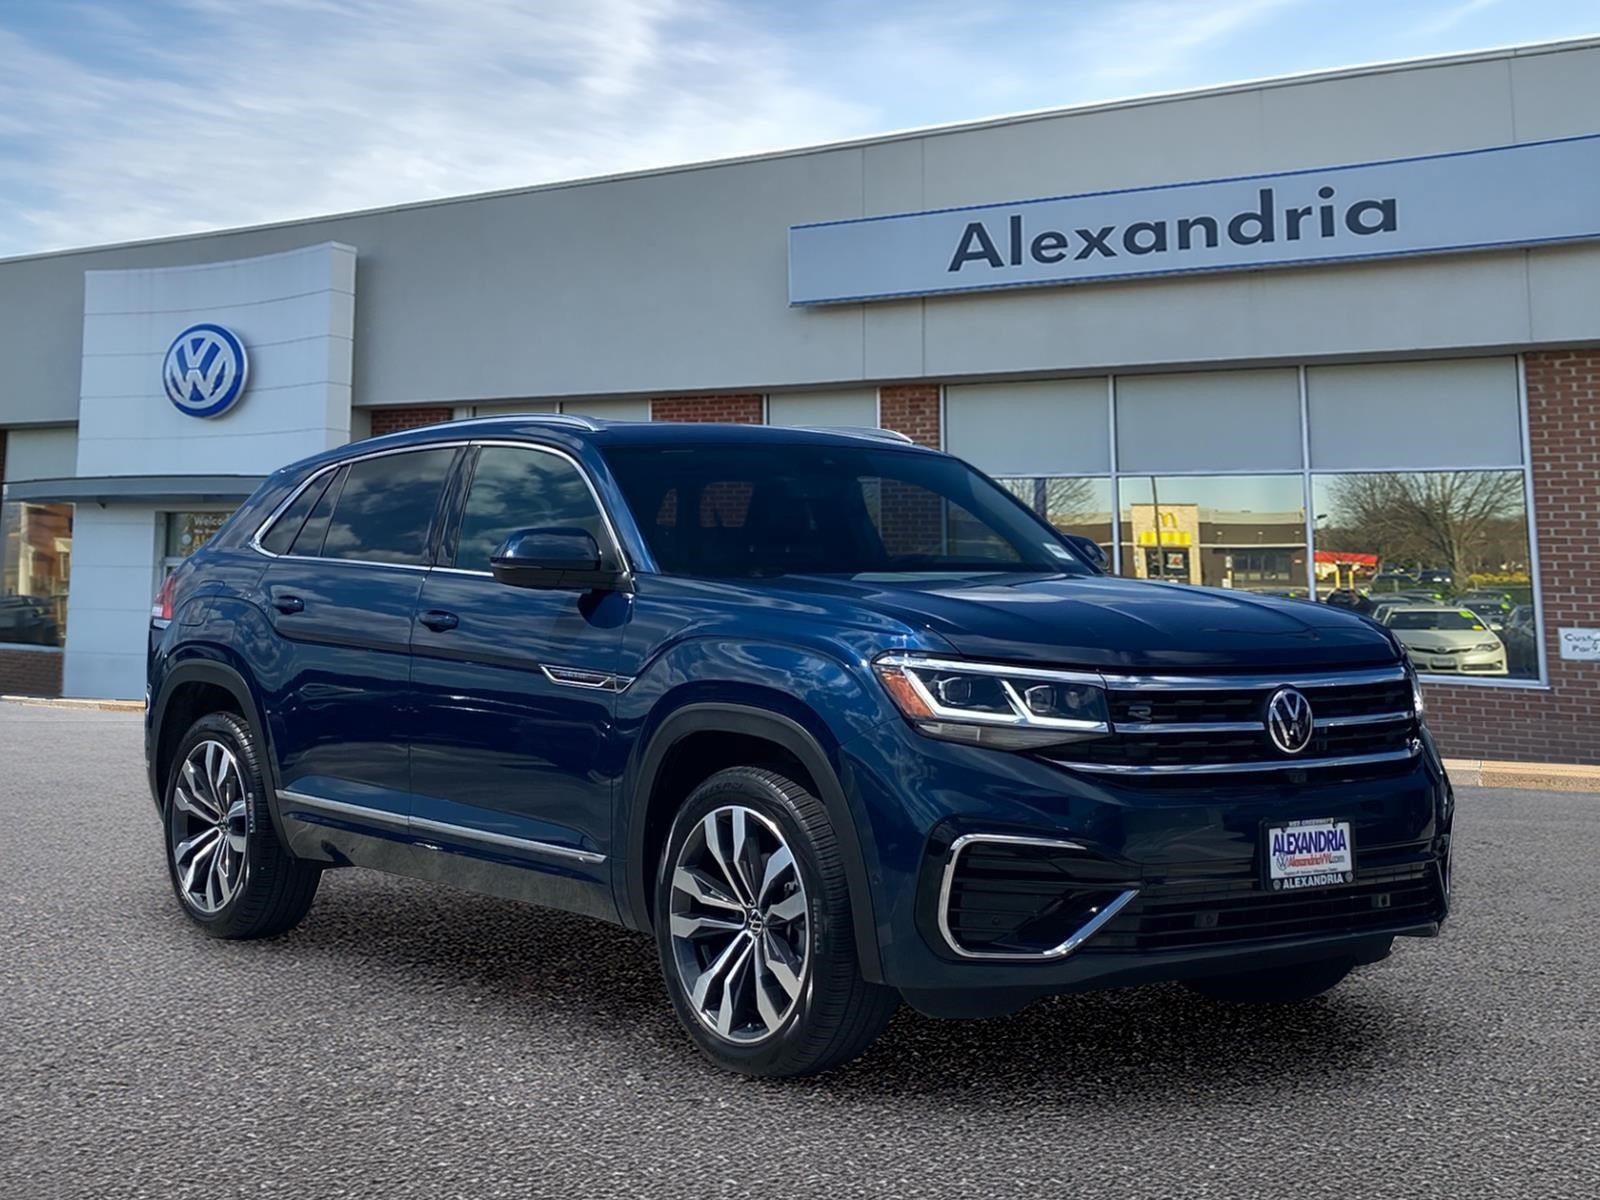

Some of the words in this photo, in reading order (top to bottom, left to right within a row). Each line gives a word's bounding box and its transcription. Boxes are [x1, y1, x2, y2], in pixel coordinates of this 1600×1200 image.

[948, 185, 1397, 272] Alexandria
[1272, 829, 1346, 856] ALEXANDRIA
[1283, 873, 1344, 889] ALEXANDRIA
